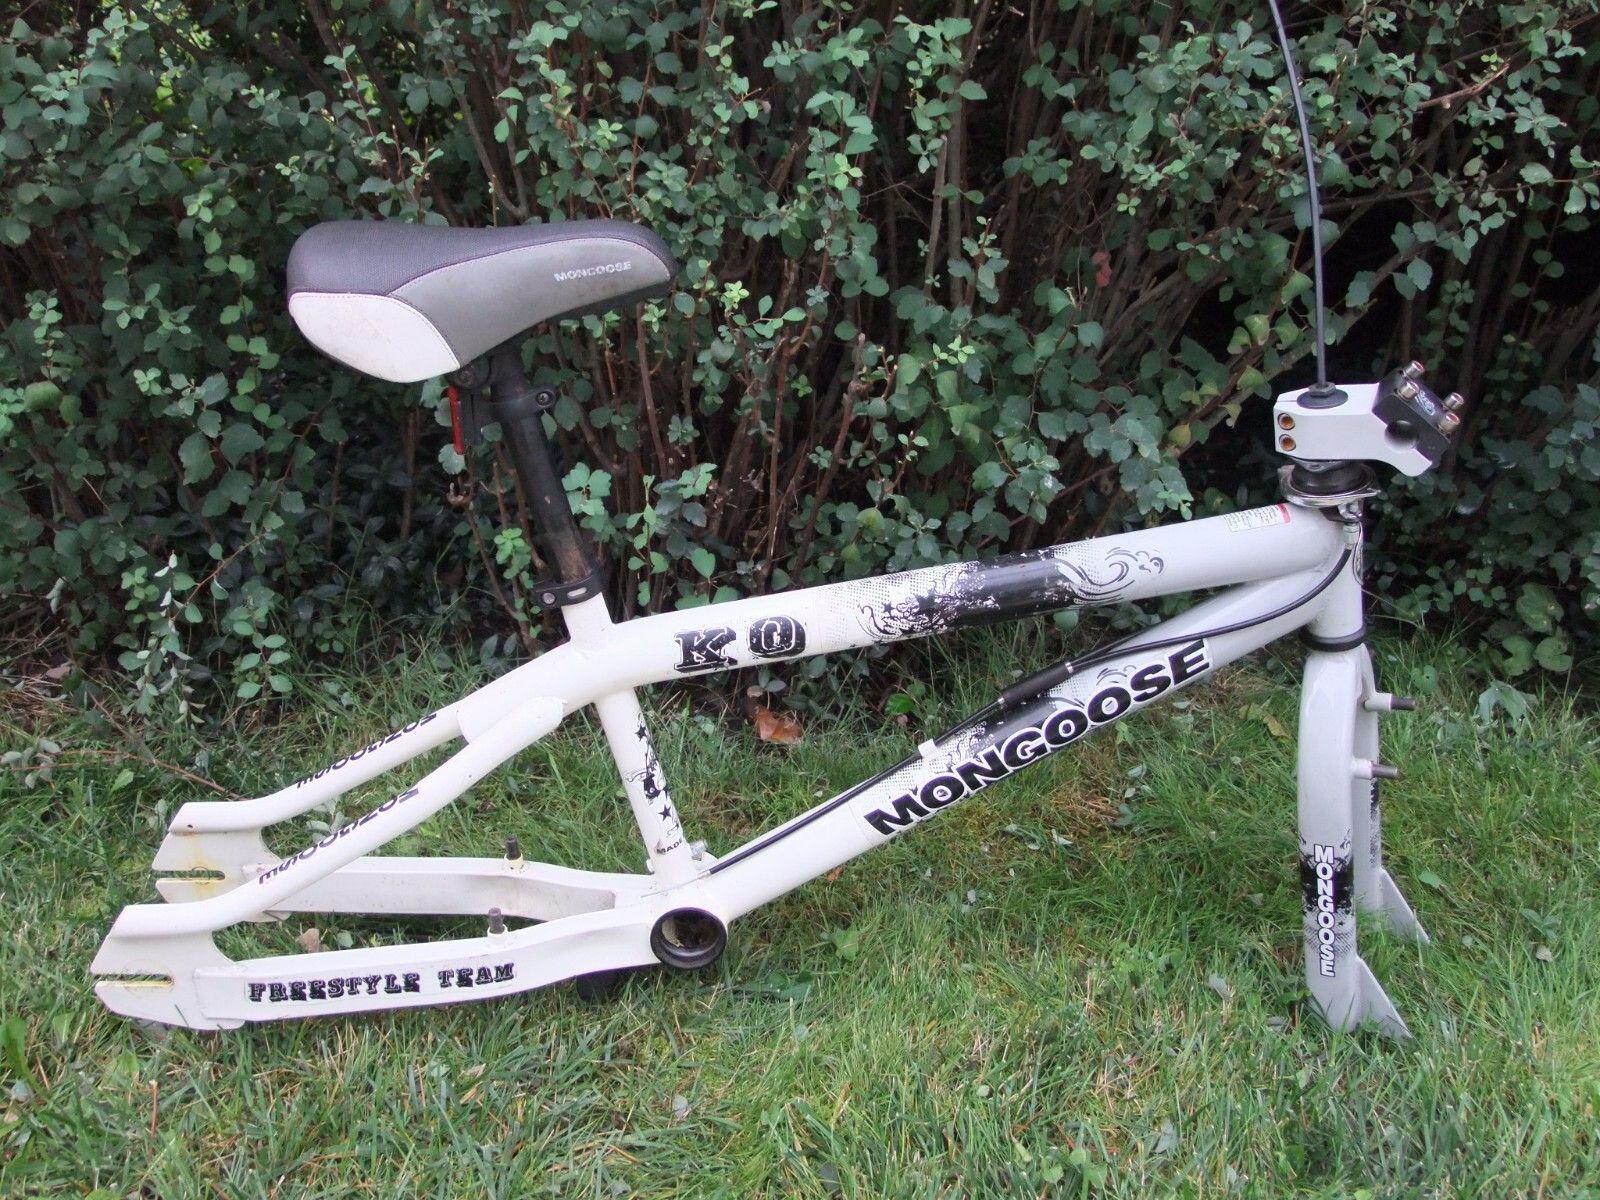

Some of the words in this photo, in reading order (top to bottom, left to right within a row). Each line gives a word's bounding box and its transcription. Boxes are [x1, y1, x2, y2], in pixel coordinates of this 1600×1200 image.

[554, 261, 632, 281] MONGOOSE
[864, 638, 1211, 836] MONGOOSE
[1313, 843, 1336, 977] MONGOOSE
[248, 972, 420, 1001] FREESTYLE
[438, 963, 514, 988] TEAM
